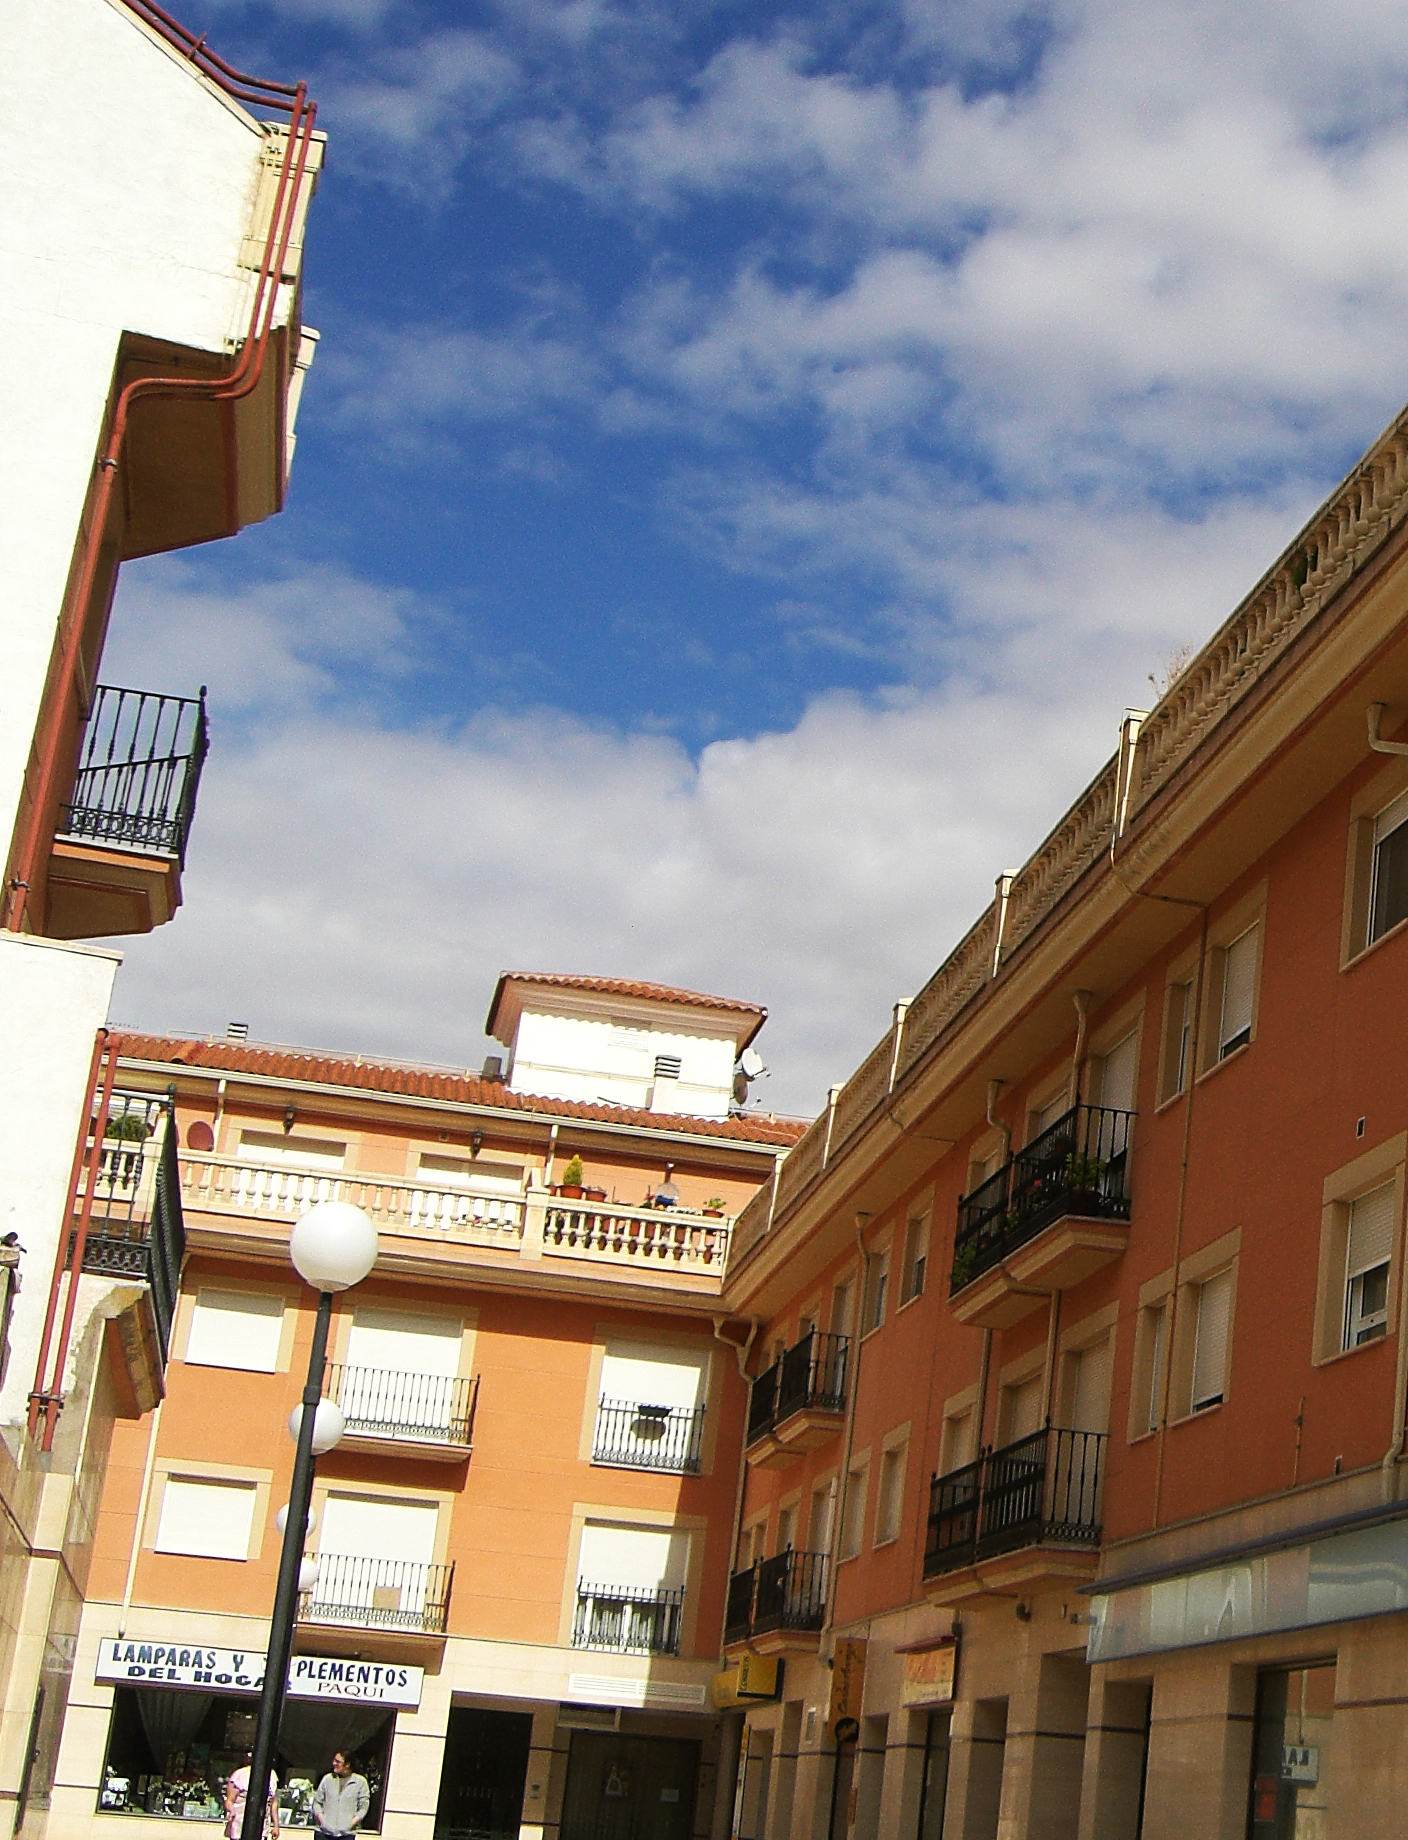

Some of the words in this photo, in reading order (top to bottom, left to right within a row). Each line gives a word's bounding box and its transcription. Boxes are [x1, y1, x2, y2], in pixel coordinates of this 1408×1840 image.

[112, 1643, 216, 1669] LAMPARAS
[232, 1654, 244, 1672] Y
[264, 1656, 407, 1687] PLEMENTOS
[128, 1665, 182, 1680] DEL
[193, 1671, 291, 1690] HOGA
[317, 1682, 385, 1698] PAQUI
